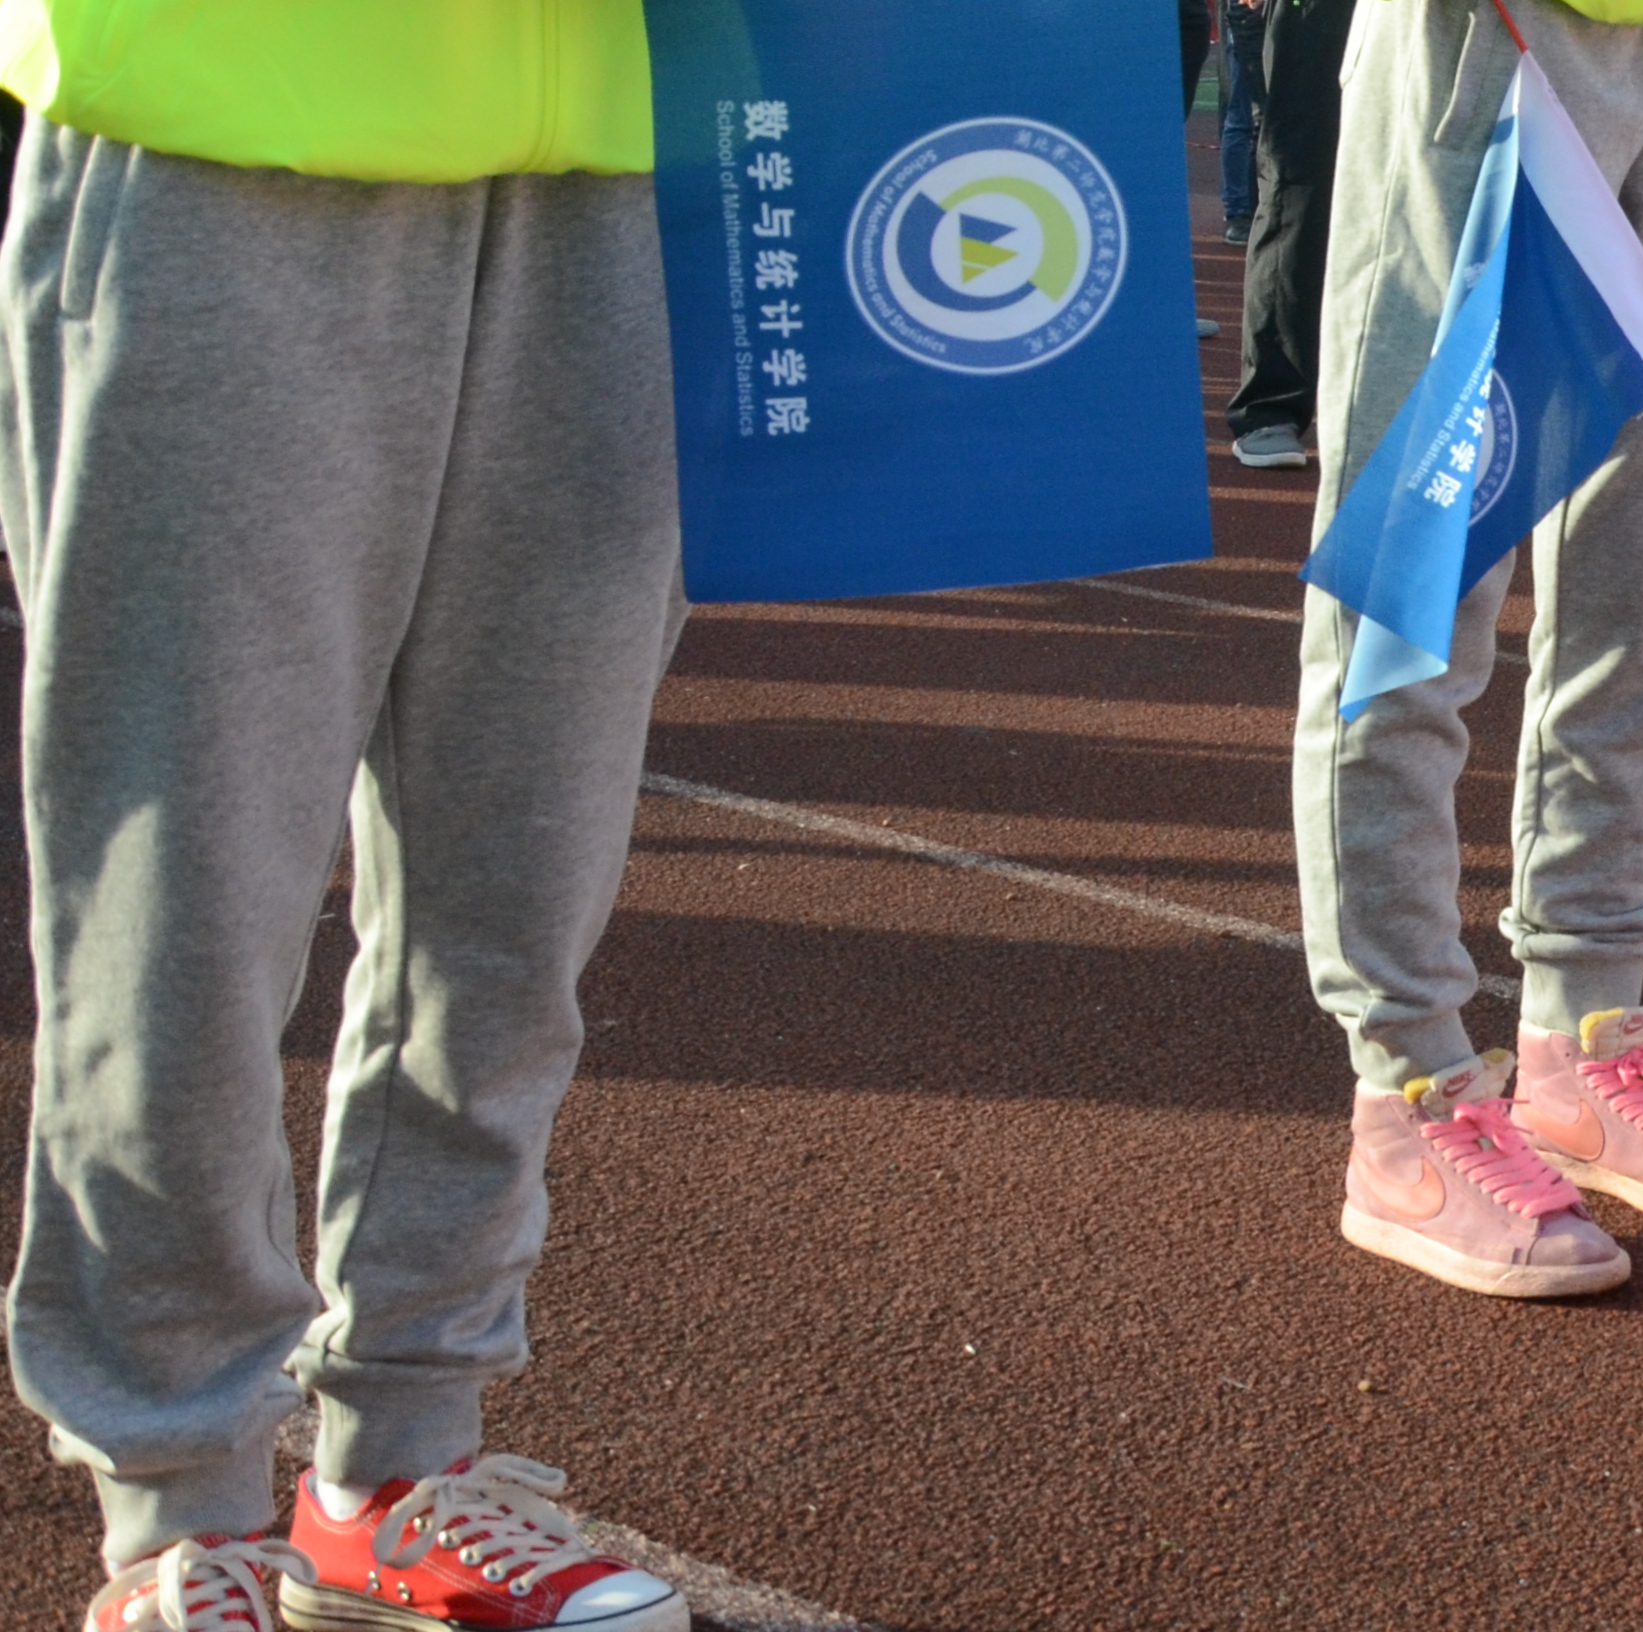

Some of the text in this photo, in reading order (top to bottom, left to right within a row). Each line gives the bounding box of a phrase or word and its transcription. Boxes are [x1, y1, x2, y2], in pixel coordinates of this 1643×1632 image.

[892, 147, 938, 187] School
[716, 99, 756, 437] School of Mathematics and Statistics
[743, 99, 810, 437] 数学与统计学院
[861, 201, 888, 293] Mathematics
[1444, 402, 1468, 429] and
[1406, 429, 1452, 491] Statistics
